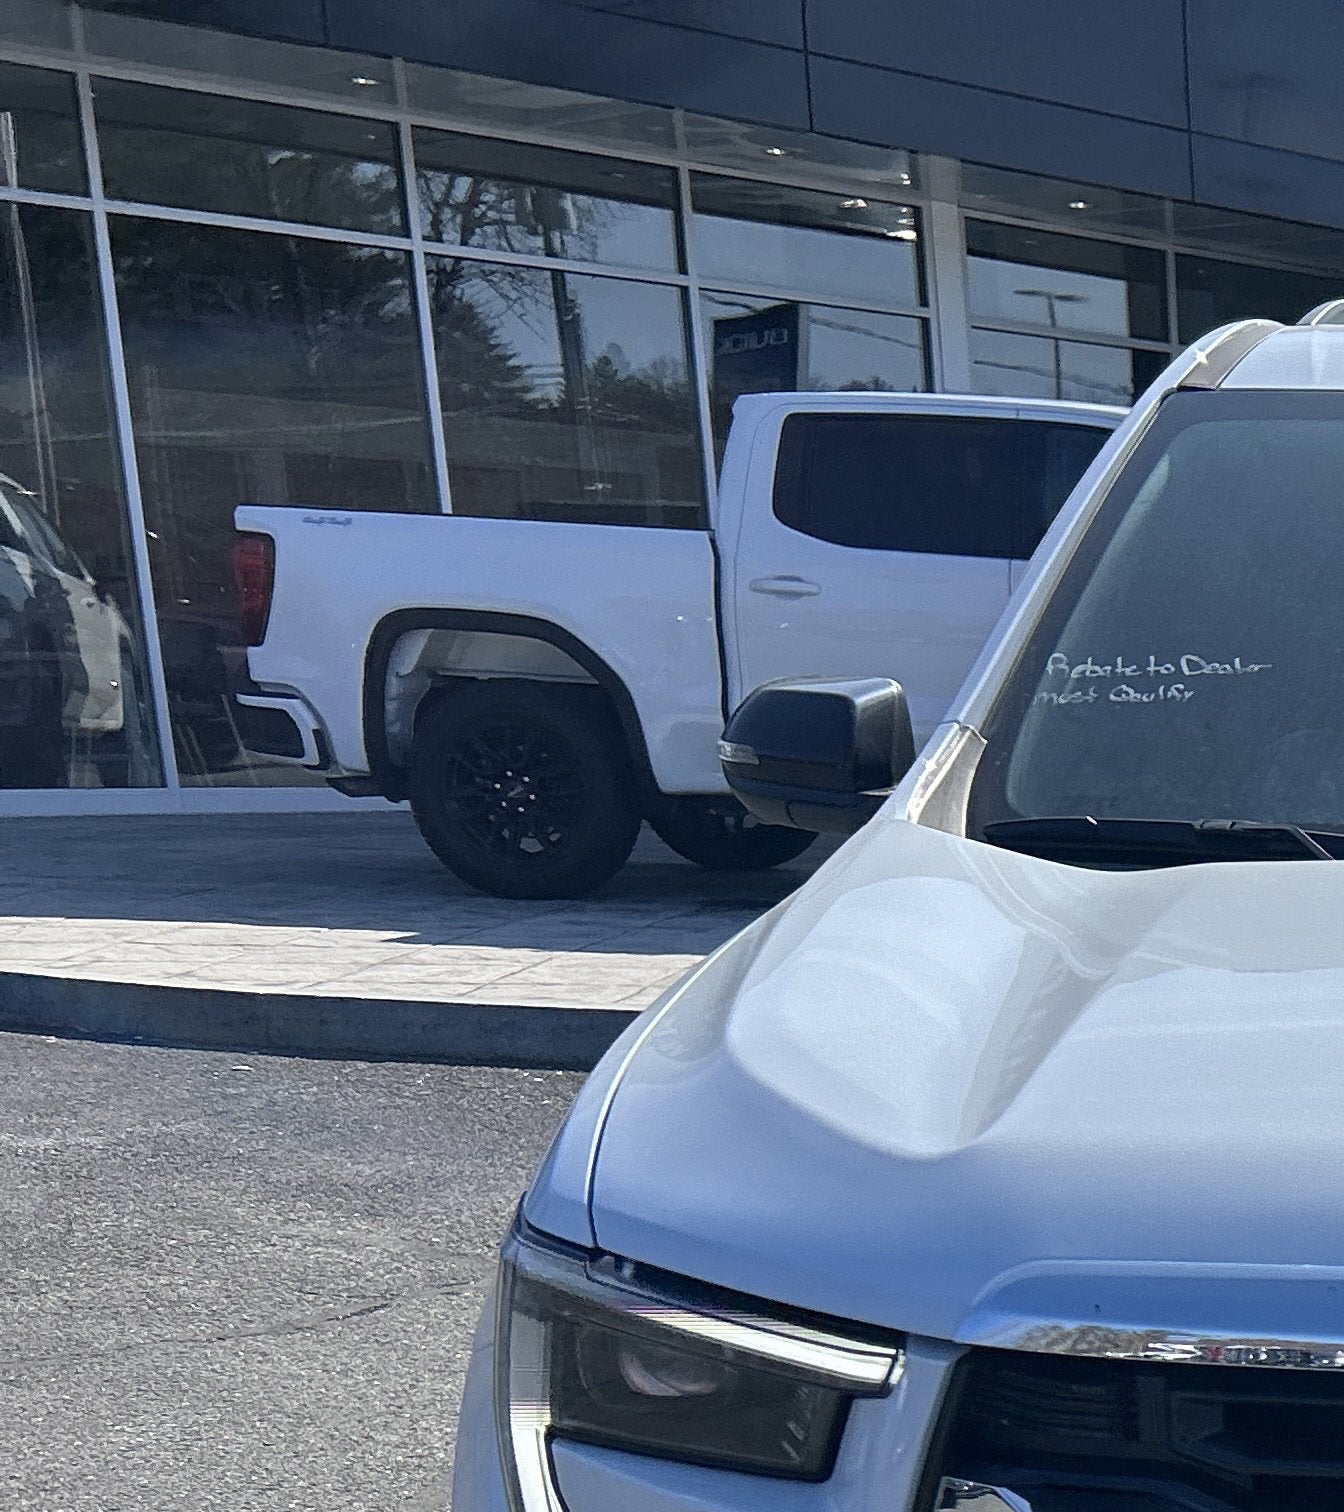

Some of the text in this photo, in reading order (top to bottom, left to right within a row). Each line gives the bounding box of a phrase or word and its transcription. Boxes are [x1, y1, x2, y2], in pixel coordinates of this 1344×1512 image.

[1047, 652, 1273, 679] Rebate to Dealer
